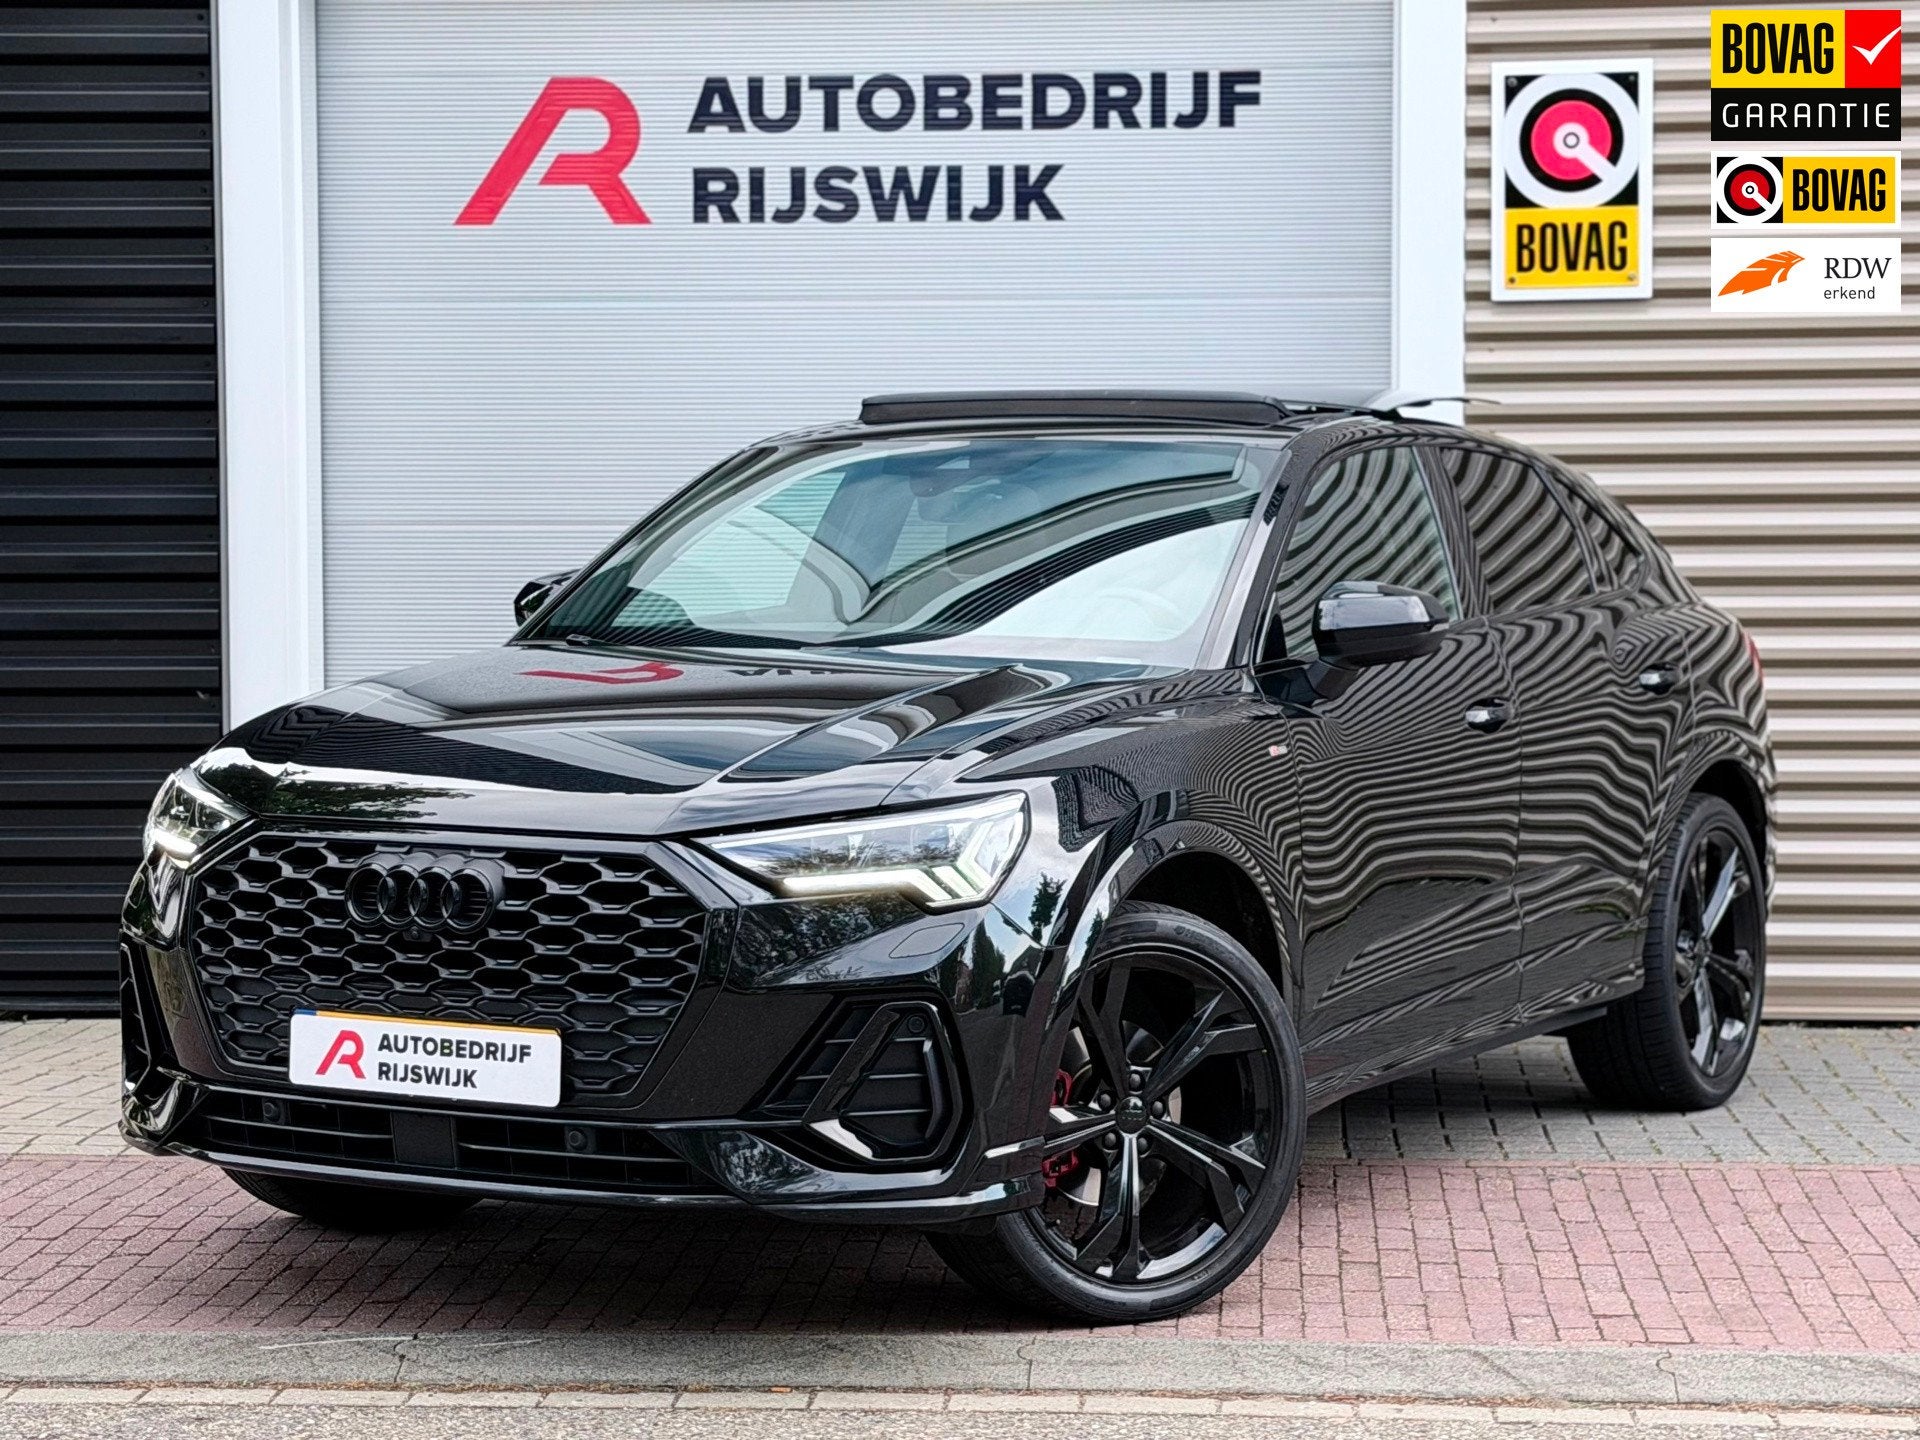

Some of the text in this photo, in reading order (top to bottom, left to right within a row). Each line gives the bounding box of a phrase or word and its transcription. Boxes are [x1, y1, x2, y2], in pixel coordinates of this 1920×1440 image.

[688, 71, 1261, 133] AUTOBEDRIJF
[692, 165, 1065, 224] RIJSWIJK
[1516, 220, 1628, 273] BOVAG
[377, 1033, 532, 1063] AUTOBEDRIJF
[377, 1062, 477, 1088] RIJSWIJK
